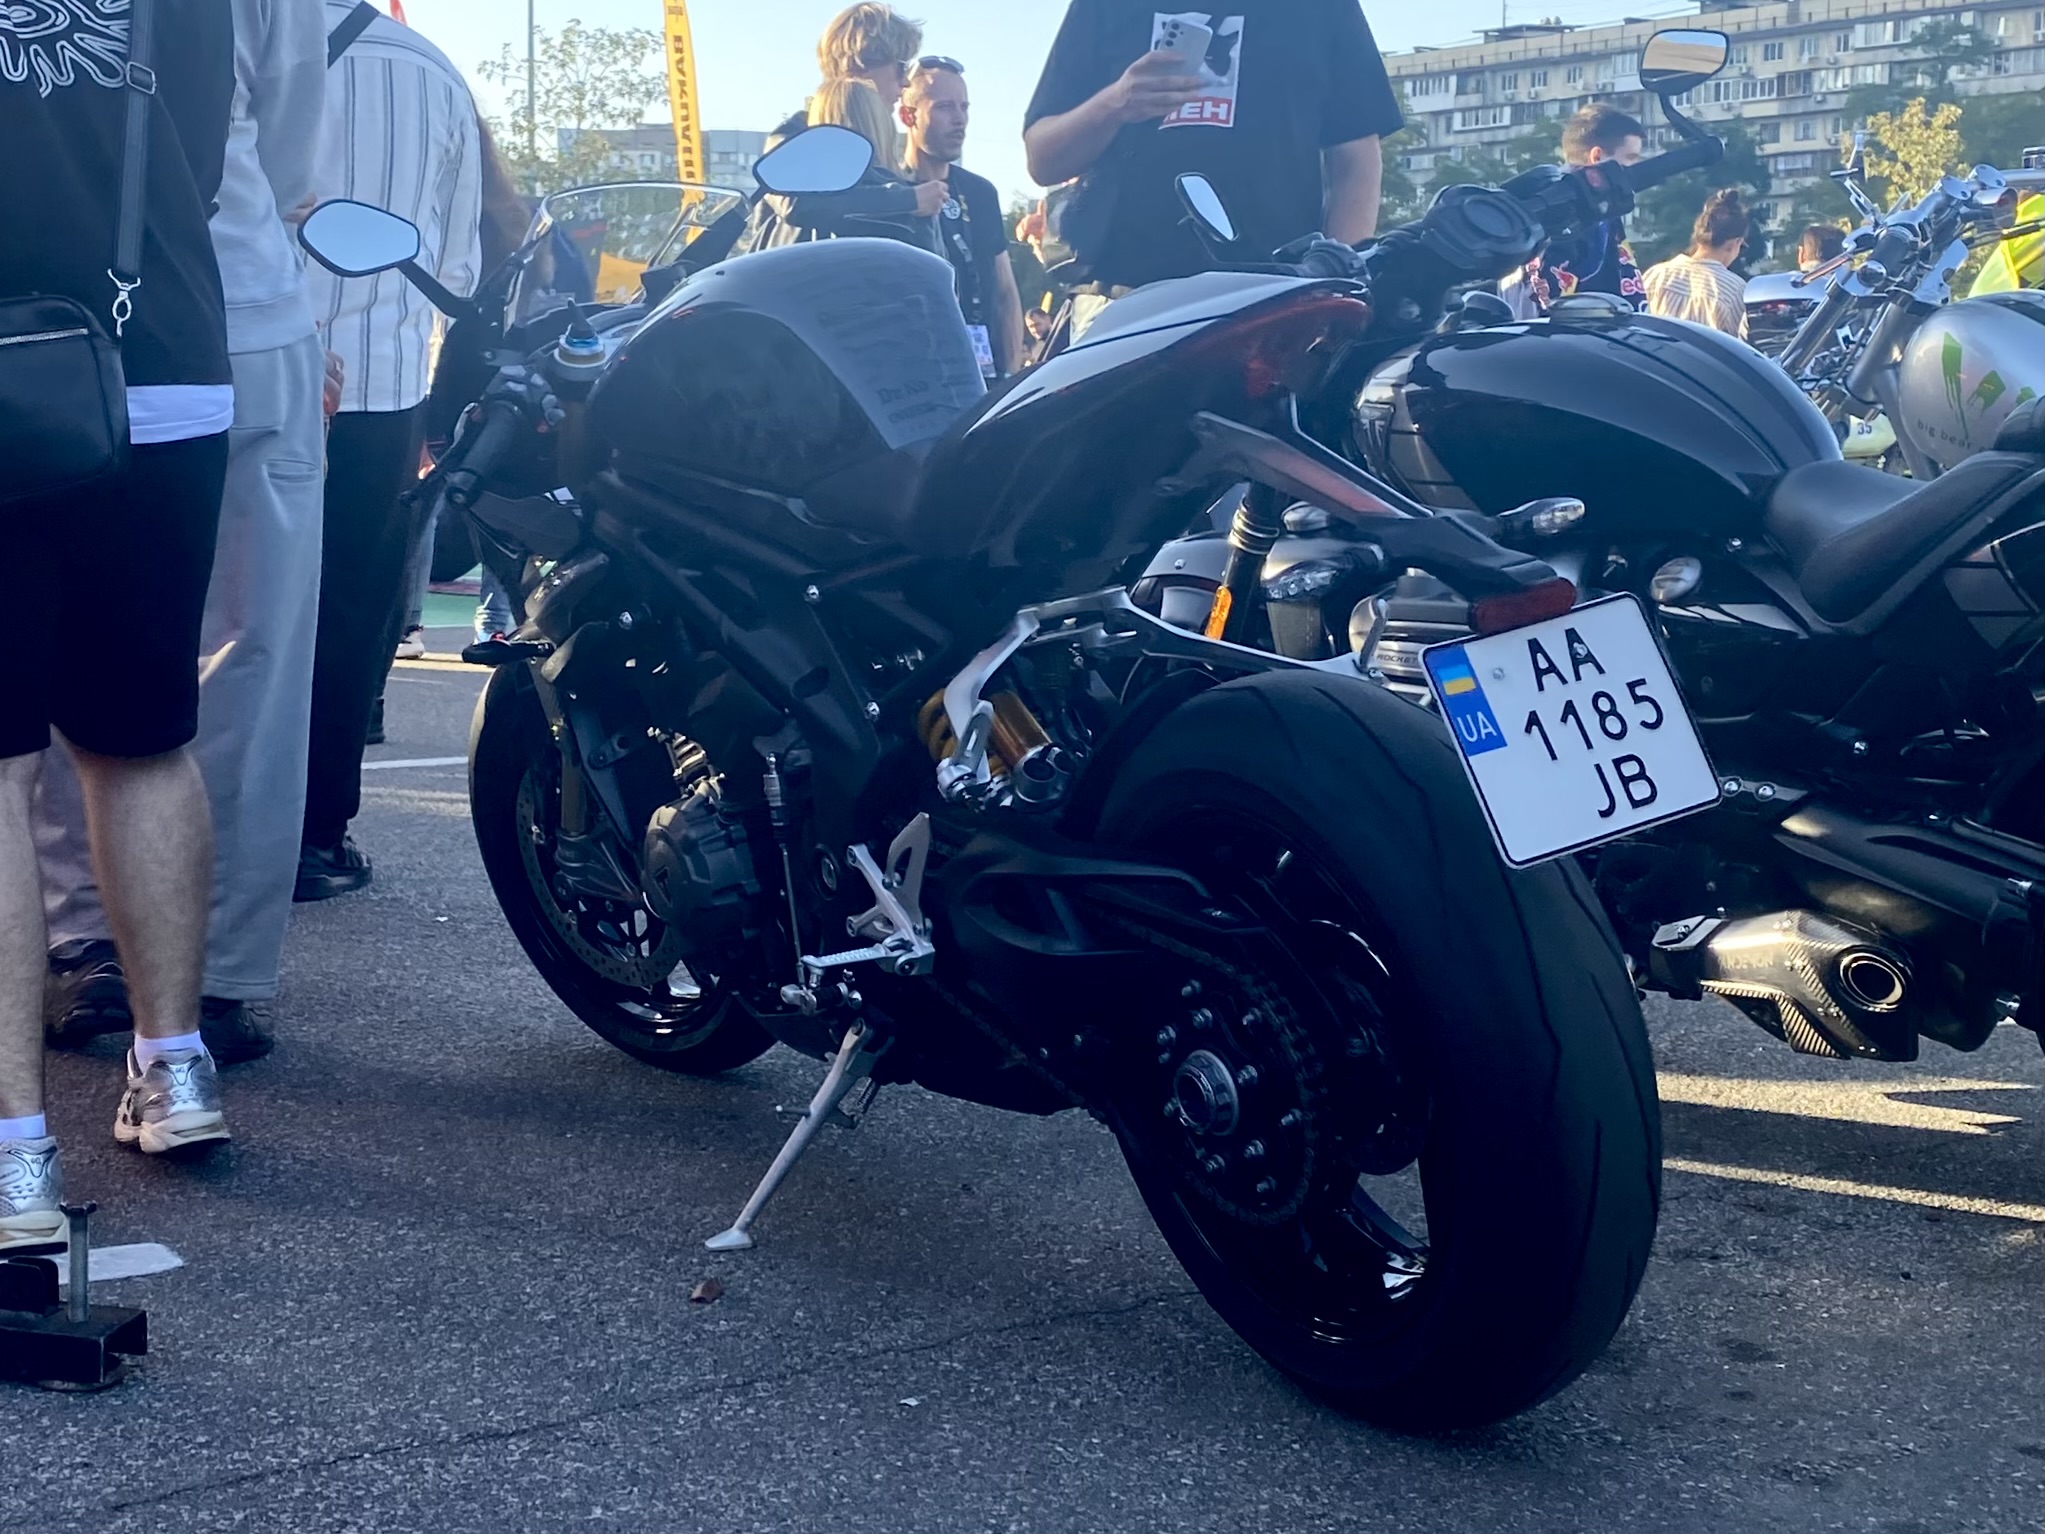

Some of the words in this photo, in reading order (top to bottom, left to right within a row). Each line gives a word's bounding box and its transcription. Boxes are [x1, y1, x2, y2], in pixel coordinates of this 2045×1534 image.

[1857, 422, 1873, 435] 35
[1917, 418, 1936, 438] big
[1376, 653, 1418, 664] ROCKET
[1527, 627, 1606, 692] AA
[1457, 711, 1497, 742] UA
[1524, 678, 1664, 761] 1185
[1593, 754, 1658, 819] JB
